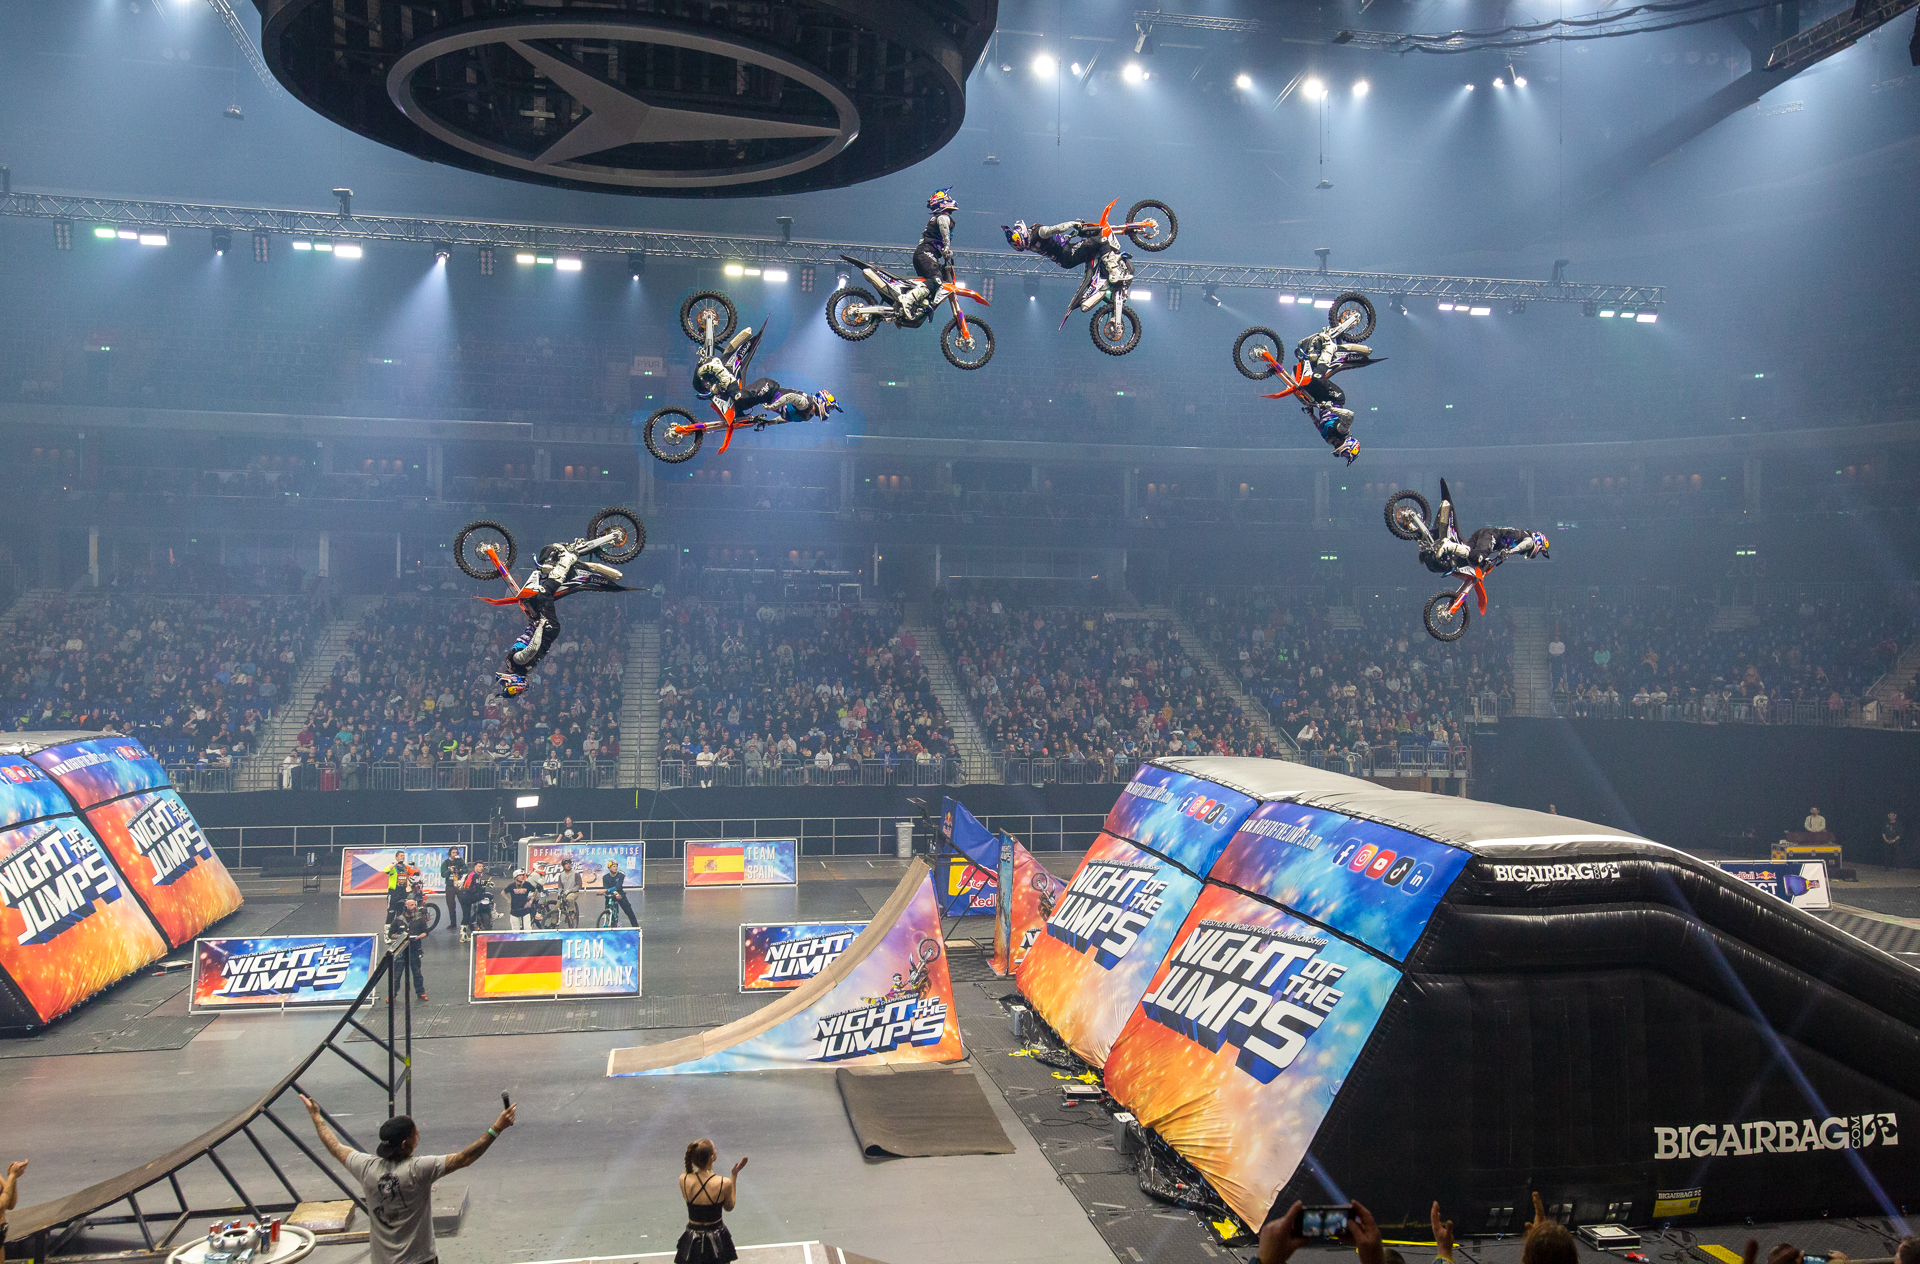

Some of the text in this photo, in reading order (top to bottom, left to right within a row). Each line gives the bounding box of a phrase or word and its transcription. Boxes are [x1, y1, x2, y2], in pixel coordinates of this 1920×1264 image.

[167, 798, 178, 811] OF
[173, 806, 189, 822] THE
[63, 827, 81, 845] OF
[129, 800, 176, 855] NIGHT
[69, 837, 96, 858] THE
[148, 819, 207, 886] JUMPS
[533, 846, 639, 857] OFFICIAL MERCHANDISE
[747, 846, 775, 860] TEAM
[421, 872, 442, 888] ECH
[747, 865, 774, 879] SPAIN
[1493, 862, 1595, 882] BIGAIRBAG
[1068, 865, 1153, 904] NIGHT
[1141, 878, 1169, 894] OF
[17, 851, 117, 946] JUMPS
[969, 894, 993, 907] Red
[1128, 891, 1165, 915] THE
[1047, 894, 1151, 958] JUMPS
[1234, 922, 1254, 932] WORLD
[1253, 925, 1273, 936] TOUR
[1271, 929, 1329, 946] CHAMPIONSHIP
[322, 946, 347, 957] OF
[566, 939, 604, 959] TEAM
[764, 933, 853, 962] NIGHT
[1171, 927, 1317, 988] NIGHT
[221, 947, 324, 976] NIGHT
[318, 953, 352, 965] THE
[1300, 958, 1348, 982] OF
[212, 963, 350, 996] JUMPS
[565, 965, 633, 987] GERMANY
[917, 996, 940, 1009] OF
[1281, 974, 1345, 1013] THE
[813, 998, 917, 1039] NIGHT
[912, 1003, 947, 1018] THE
[1141, 965, 1325, 1069] JUMPS
[806, 1013, 946, 1060] JUMPS
[1654, 1117, 1850, 1160] BIGAIRBAG
[1658, 1191, 1693, 1199] BIGAIRBAG
